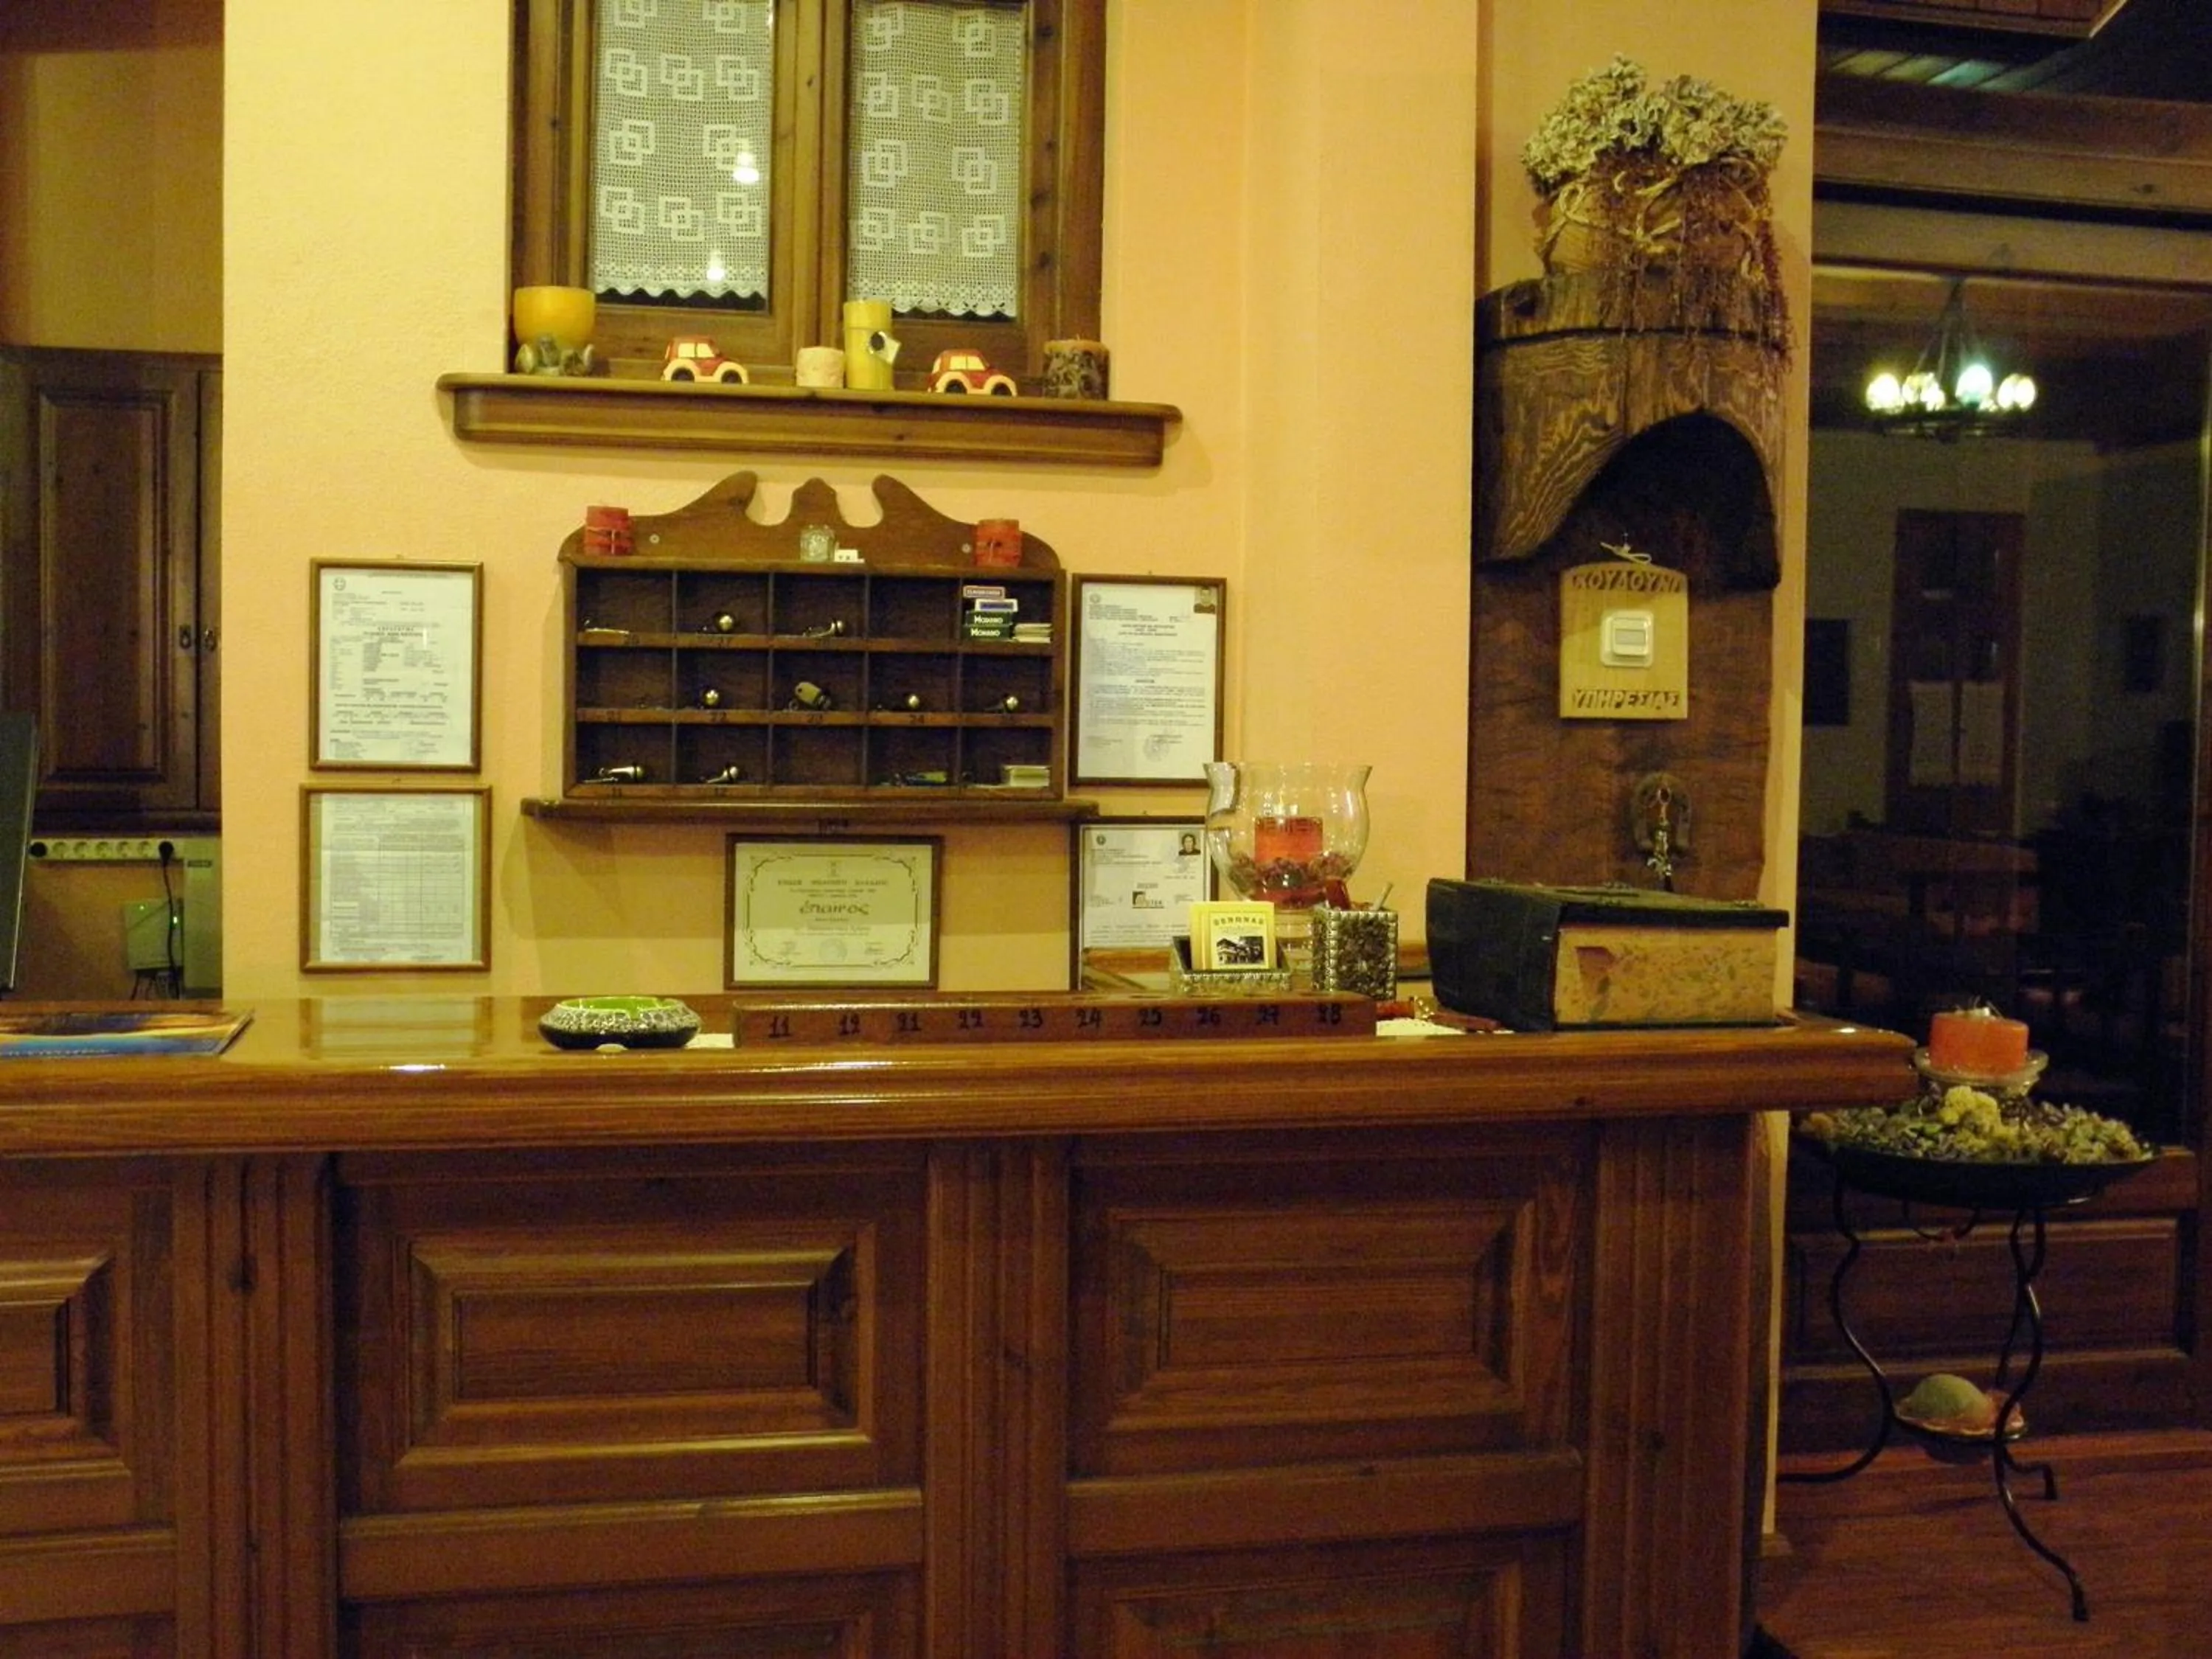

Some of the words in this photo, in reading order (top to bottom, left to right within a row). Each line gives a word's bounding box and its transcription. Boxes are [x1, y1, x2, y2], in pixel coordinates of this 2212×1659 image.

[1571, 569, 1682, 594] ΚΟΥΔΟΥΝΙ
[768, 1015, 792, 1038] 11
[838, 1014, 860, 1035] 12
[896, 1012, 922, 1032] 21
[959, 1009, 984, 1029] 22
[1019, 1008, 1043, 1028] 23
[1077, 1007, 1102, 1029] 24
[1139, 1007, 1162, 1026] 25
[1197, 1006, 1221, 1026] 26
